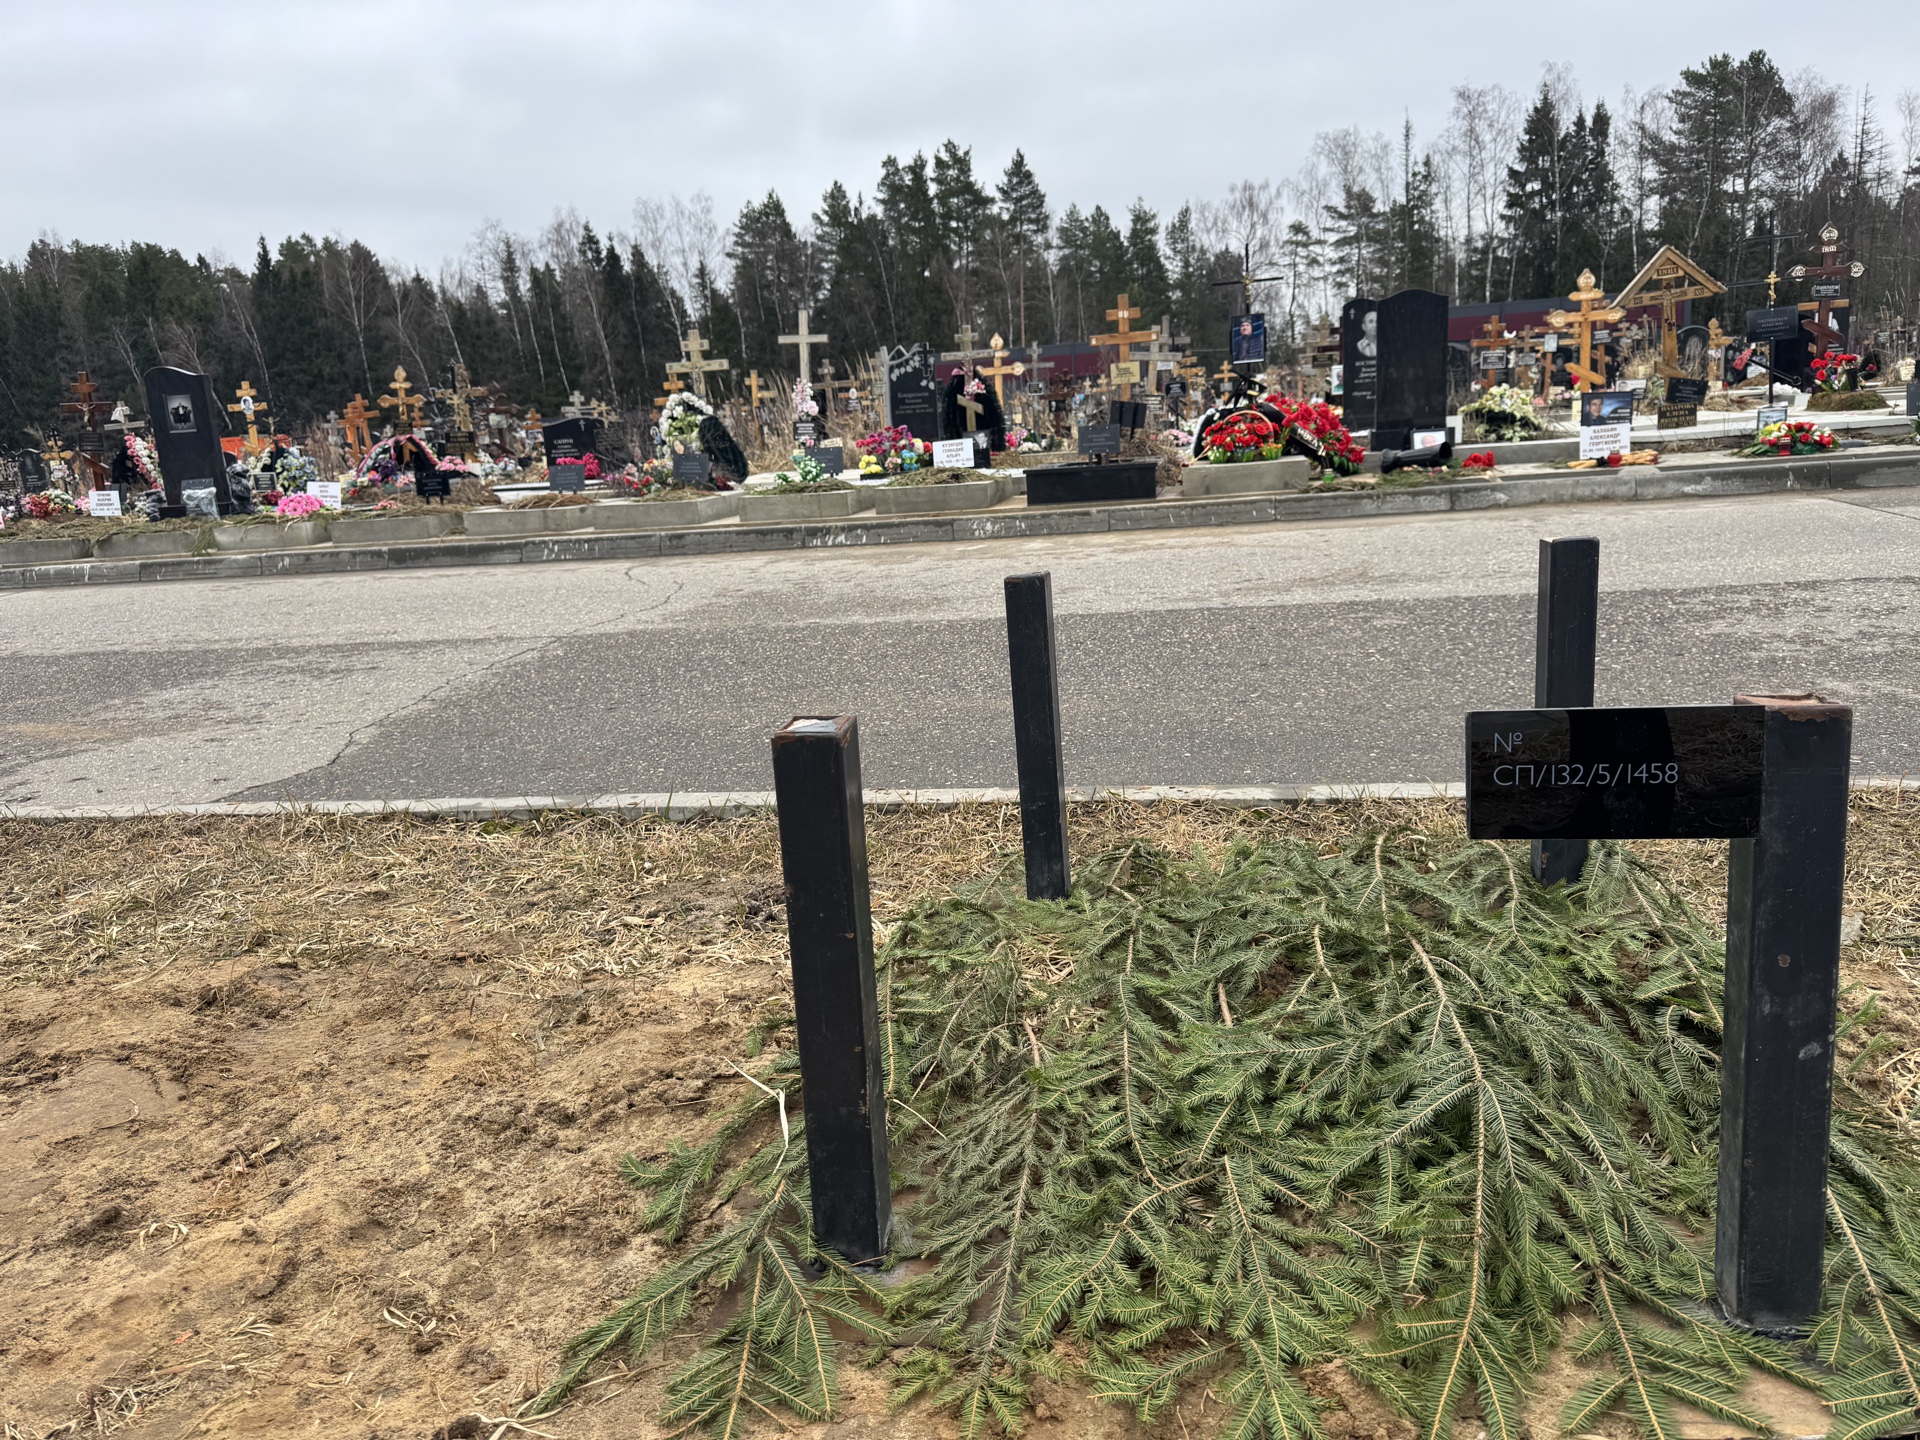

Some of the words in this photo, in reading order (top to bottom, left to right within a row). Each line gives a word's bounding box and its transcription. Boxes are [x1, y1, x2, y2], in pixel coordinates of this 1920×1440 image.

[1588, 439, 1621, 447] ГЕОРГИЕВИЧ
[1493, 732, 1523, 753] №
[1493, 763, 1679, 787] СП/132/5/1458
